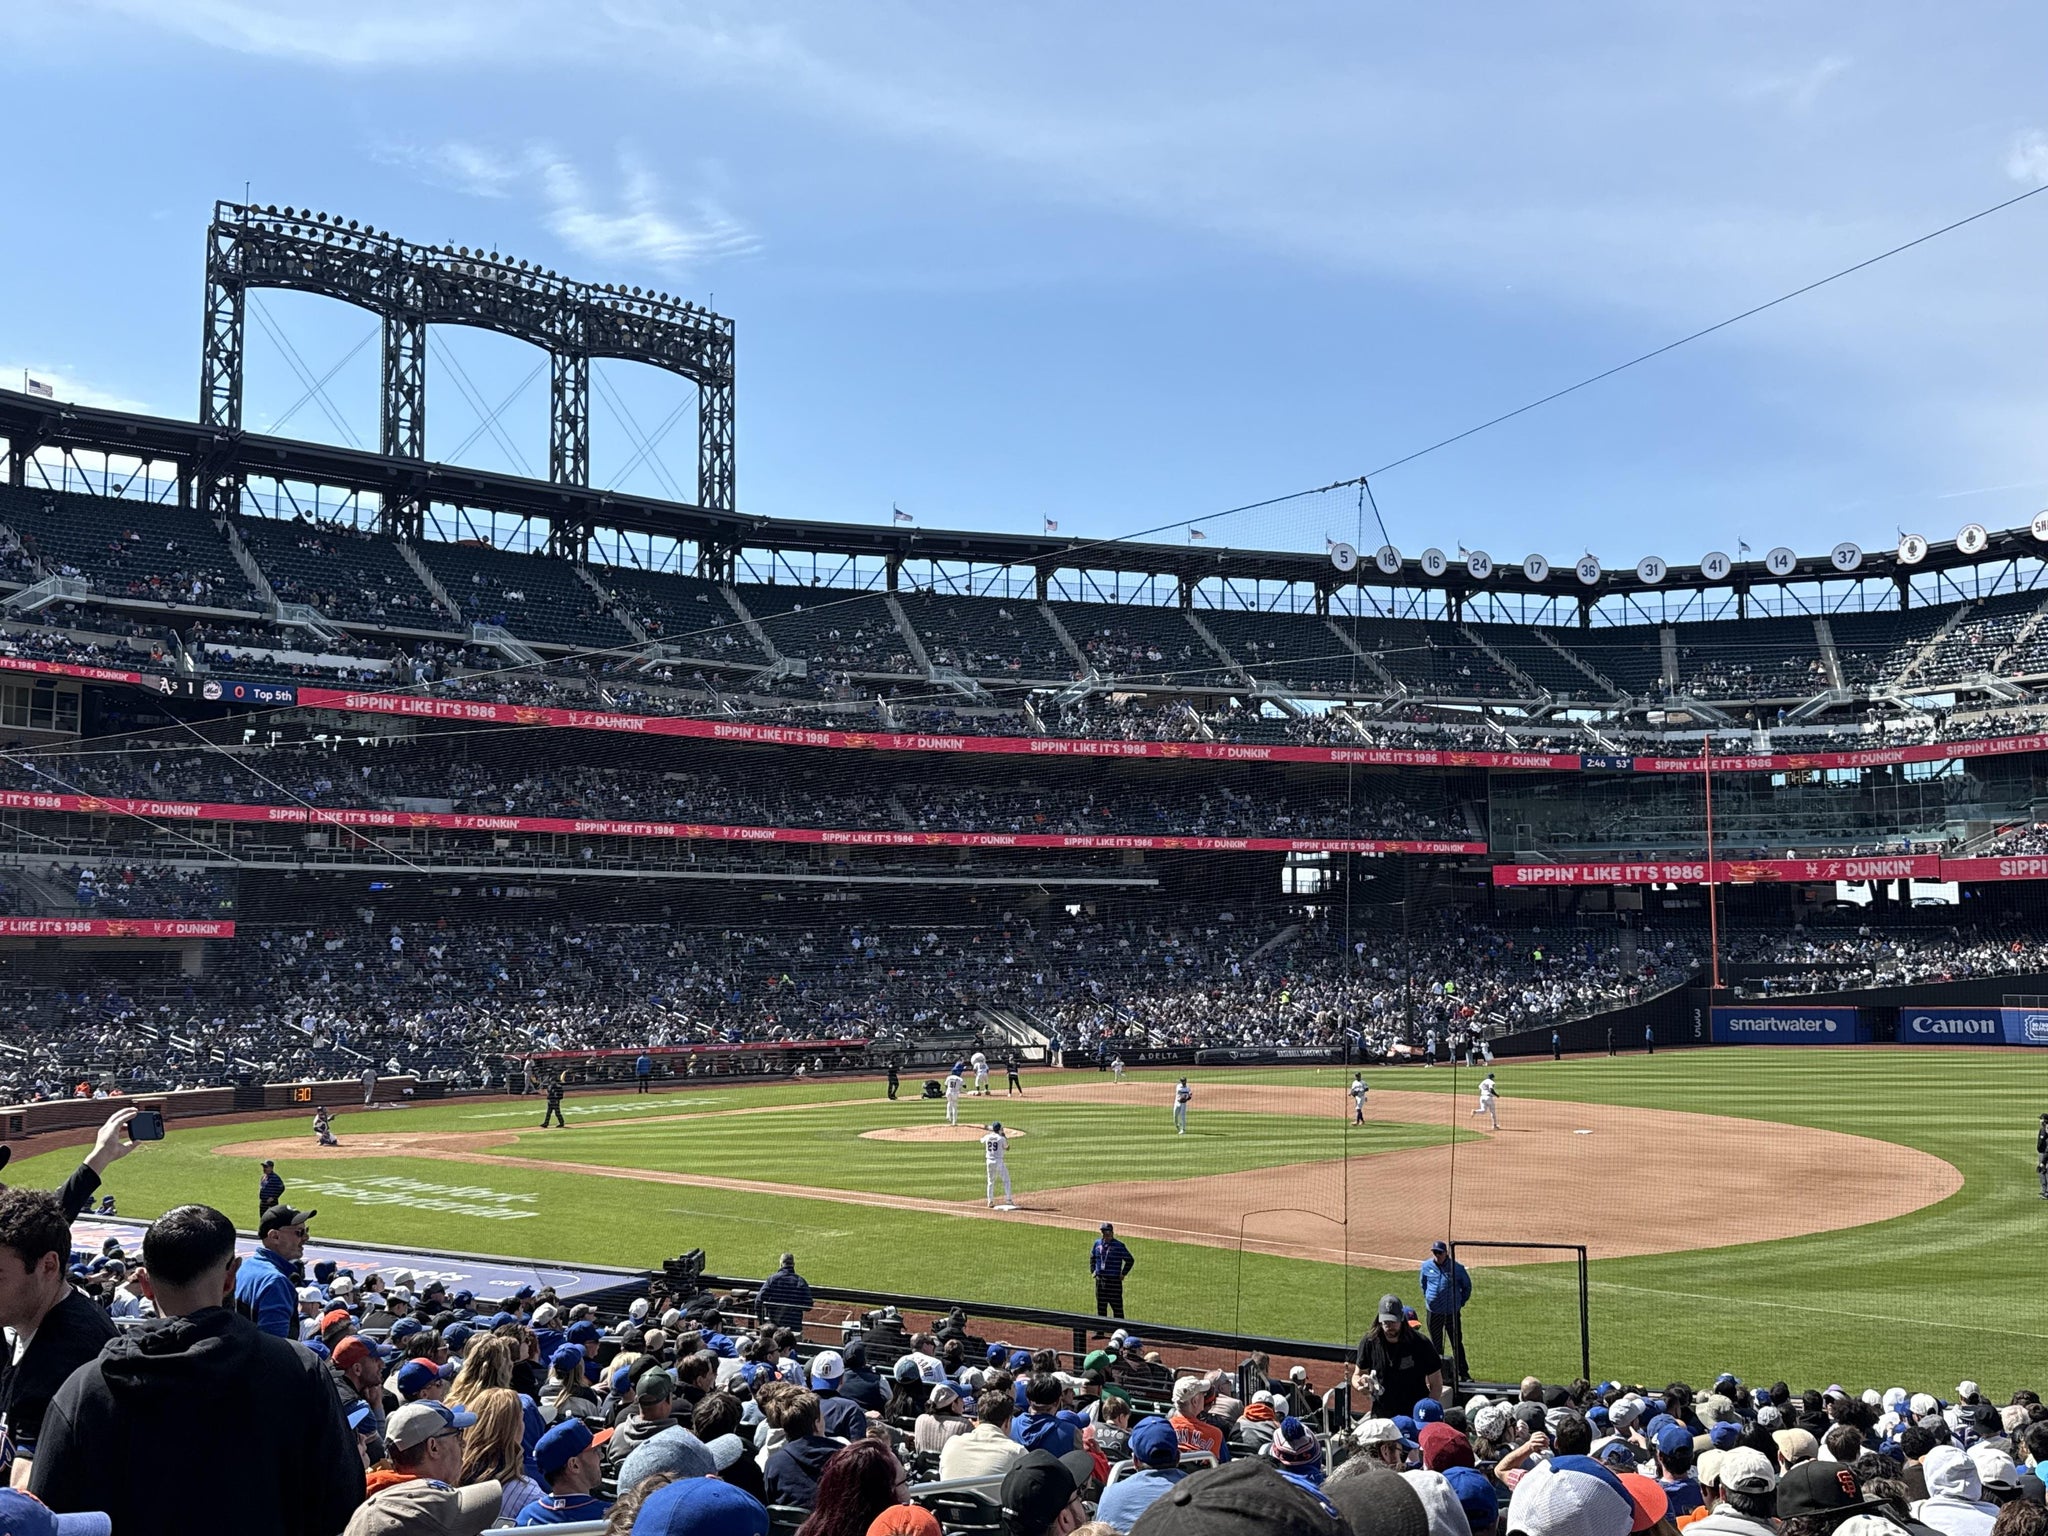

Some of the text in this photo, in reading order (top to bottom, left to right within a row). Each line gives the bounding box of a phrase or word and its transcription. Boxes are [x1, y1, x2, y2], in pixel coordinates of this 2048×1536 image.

[1341, 551, 1348, 563] 5
[1429, 556, 1439, 568] 16
[1775, 555, 1787, 568] 14
[1838, 550, 1855, 563] 37
[1473, 559, 1487, 571] 24
[1531, 562, 1541, 574] 17
[1582, 565, 1595, 577] 36
[1646, 564, 1657, 576] 31
[1709, 560, 1721, 572] 41
[18, 661, 36, 669] 1986
[97, 670, 128, 681] DUNKIN'
[160, 677, 193, 695] A's 1
[234, 686, 292, 702] 0 Top 5th
[345, 694, 496, 718] SIPPIN' LIKE IT'S 1986
[595, 716, 645, 729] DUNKIN'
[714, 725, 829, 744] SIPPIN' LIKE IT'S 1986
[918, 738, 964, 749] DUNKIN'
[1031, 741, 1146, 754] SIPPIN' LIKE IT'S 1986
[1947, 743, 1987, 755] SIPPIN'
[1990, 740, 2015, 751] LIKE
[2019, 738, 2040, 750] IT'S
[1228, 748, 1270, 758] DUNKIN'
[1370, 752, 1391, 761] LIKE
[1394, 753, 1412, 762] IT'S
[1415, 754, 1437, 763] 1986
[1861, 751, 1904, 763] DUNKIN'
[1513, 757, 1552, 766] DUNKIN'
[1587, 758, 1606, 768] 2:46
[1655, 761, 1689, 770] SIPPIN'
[1721, 759, 1742, 769] IT'S
[1745, 759, 1772, 768] 1986
[7, 794, 30, 805] IT'S
[33, 796, 61, 807] 1986
[152, 804, 201, 816] DUNKIN'
[317, 811, 342, 822] LIKE
[346, 813, 366, 822] IT'S
[369, 814, 394, 823] 1986
[477, 819, 519, 829] DUNKIN'
[575, 822, 674, 835] SIPPIN' LIKE IT'S 1986
[742, 830, 776, 838] DUNKIN'
[822, 833, 850, 841] SIPPIN'
[853, 834, 872, 842] LIKE
[981, 836, 1016, 844] DUNKIN'
[1064, 837, 1094, 846] SIPPIN'
[1134, 839, 1152, 847] 1986
[1215, 840, 1247, 848] DUNKIN'
[1292, 841, 1320, 849] SIPPIN'
[1517, 866, 1703, 881] SIPPIN' LIKE IT'S 1986
[1846, 860, 1914, 876] DUNKIN'
[10, 921, 37, 931] LIKE
[40, 922, 61, 931] IT'S
[65, 922, 91, 932] 1986
[177, 924, 220, 933] DUNKIN'
[1730, 1017, 1823, 1032] smartwater
[1912, 1016, 1996, 1034] Canon
[1148, 1052, 1178, 1060] DELTA
[987, 1142, 998, 1151] 29
